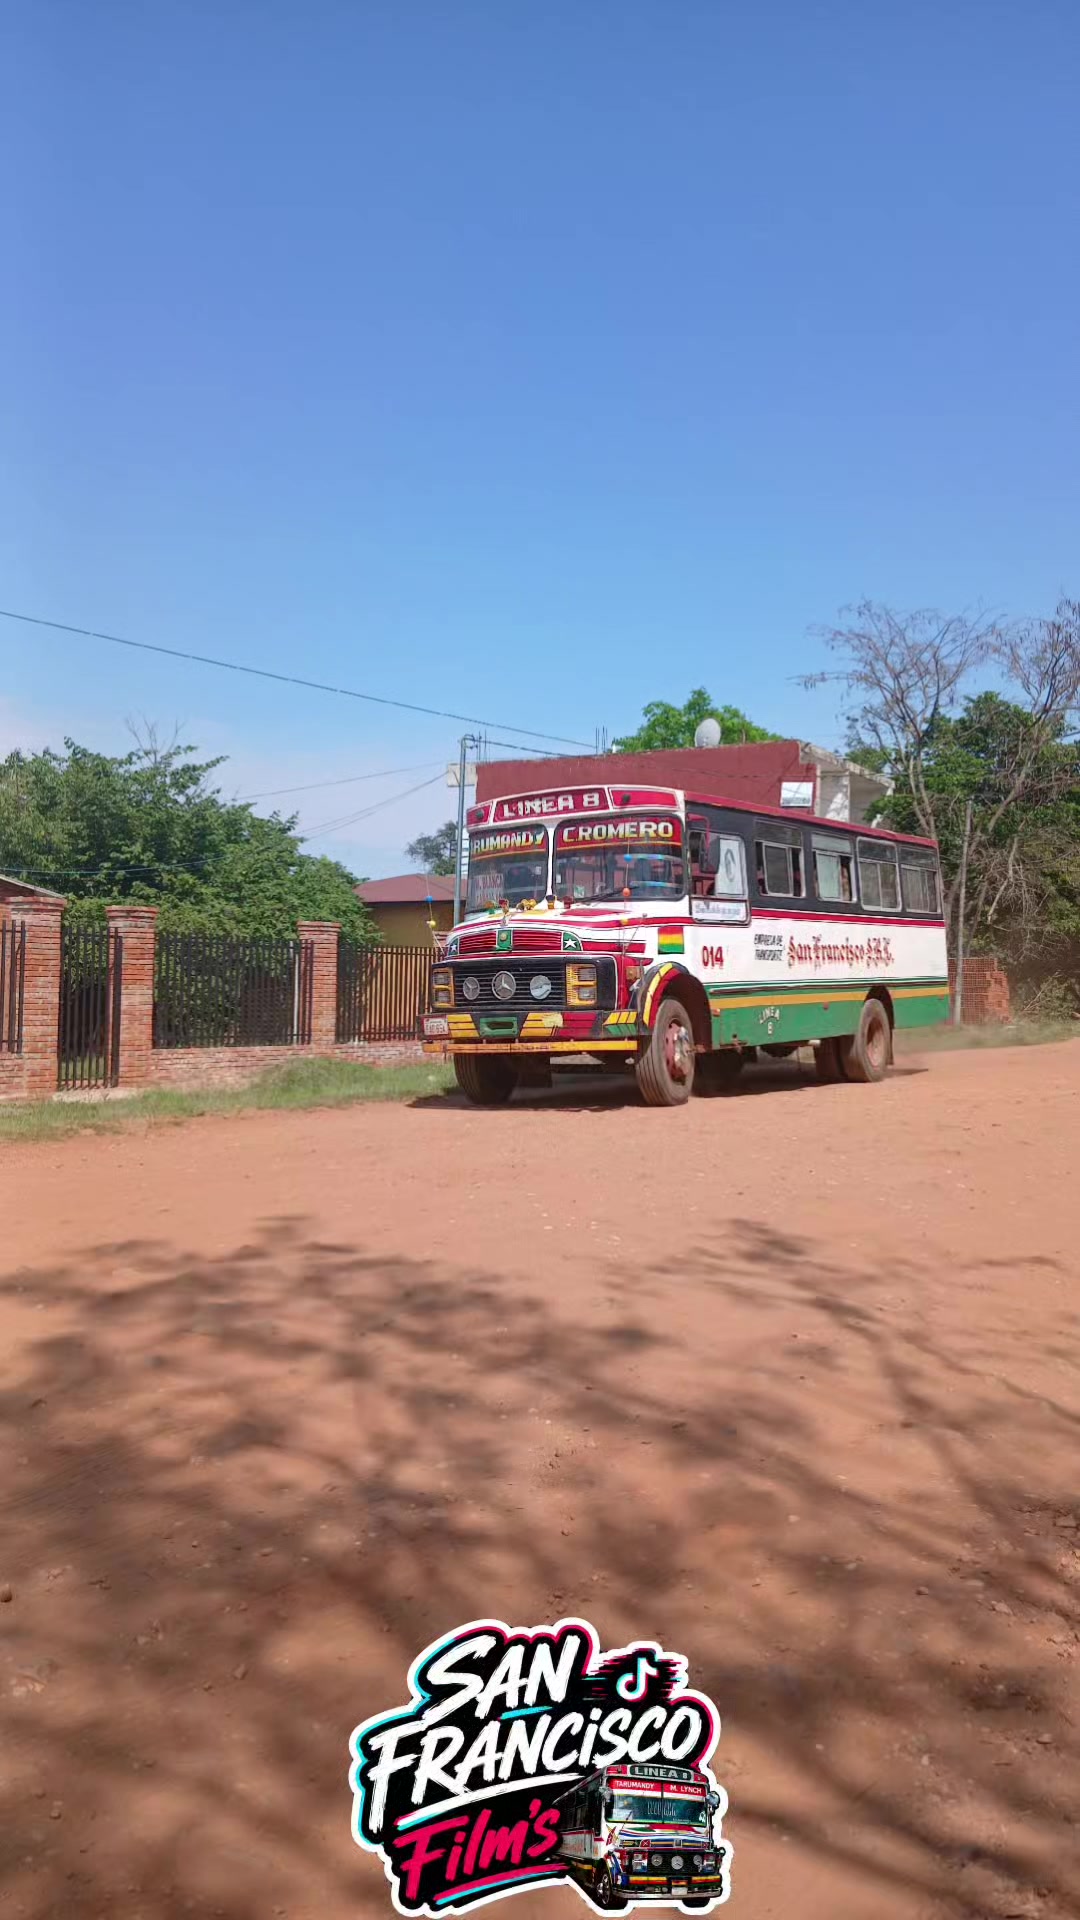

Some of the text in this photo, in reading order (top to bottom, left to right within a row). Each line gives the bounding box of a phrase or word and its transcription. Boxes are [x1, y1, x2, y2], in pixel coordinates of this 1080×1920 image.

[503, 791, 600, 818] LINEA 8
[471, 829, 545, 855] RUMANDY
[702, 946, 724, 968] 014
[759, 1006, 780, 1024] LINEA
